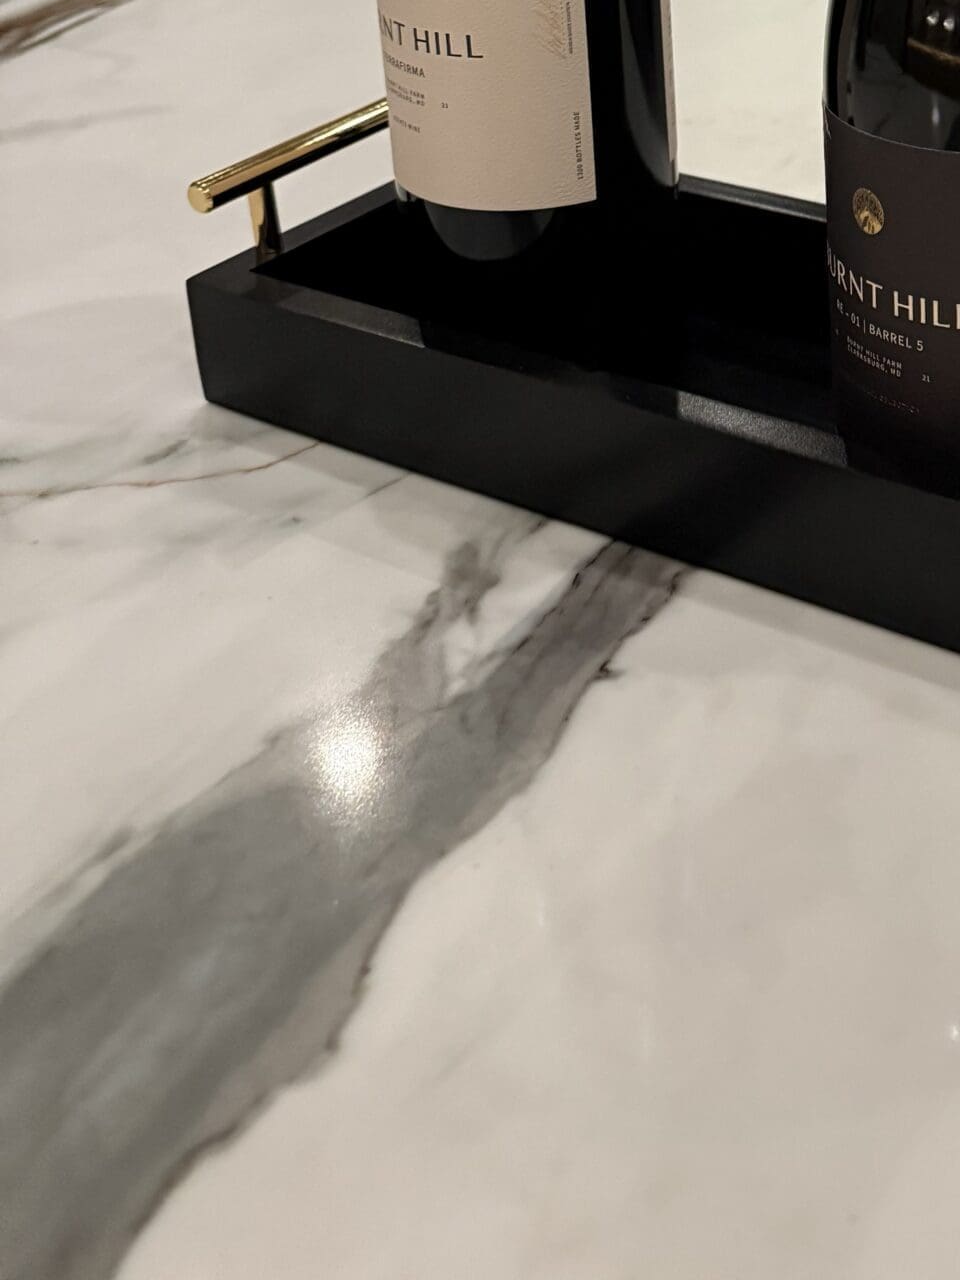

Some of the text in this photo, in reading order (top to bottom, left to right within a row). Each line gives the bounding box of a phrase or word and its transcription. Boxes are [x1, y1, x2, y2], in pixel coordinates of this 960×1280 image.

[379, 12, 484, 59] NT HILL
[572, 111, 581, 131] MADE
[574, 131, 583, 163] BOTTLES
[869, 323, 912, 350] BARREL
[917, 338, 924, 352] 5
